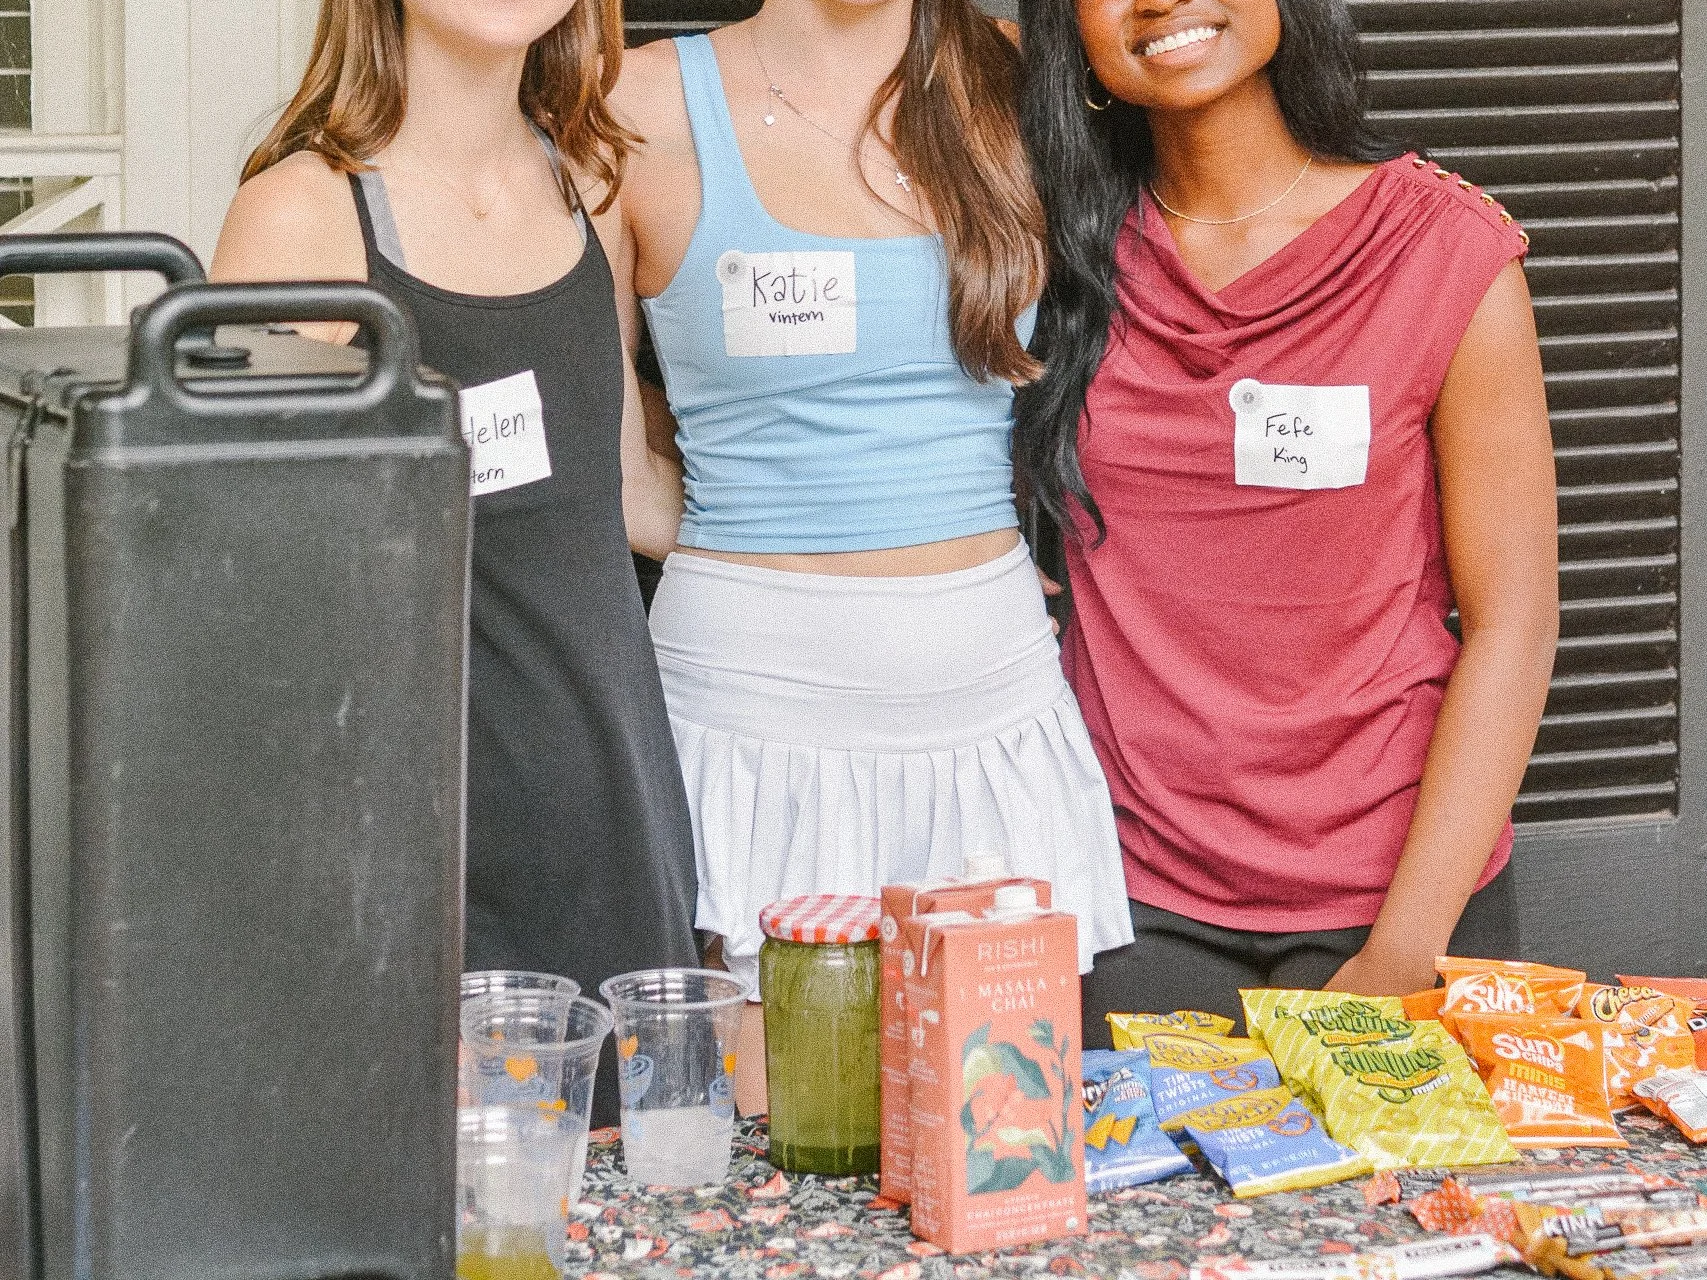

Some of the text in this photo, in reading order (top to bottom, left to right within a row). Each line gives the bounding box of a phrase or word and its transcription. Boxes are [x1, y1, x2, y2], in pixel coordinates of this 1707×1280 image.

[752, 267, 840, 307] Katie
[1265, 413, 1313, 437] Fefe
[1273, 447, 1308, 473] King
[470, 468, 504, 483] tern
[978, 936, 1045, 961] RISHI
[978, 977, 1047, 998] MASALA
[991, 993, 1035, 1012] CHAI
[1492, 1032, 1564, 1062] Sun
[1157, 1080, 1206, 1102] TWISTS
[1163, 1073, 1191, 1088] TINY
[1158, 1092, 1215, 1115] ORIGINAL
